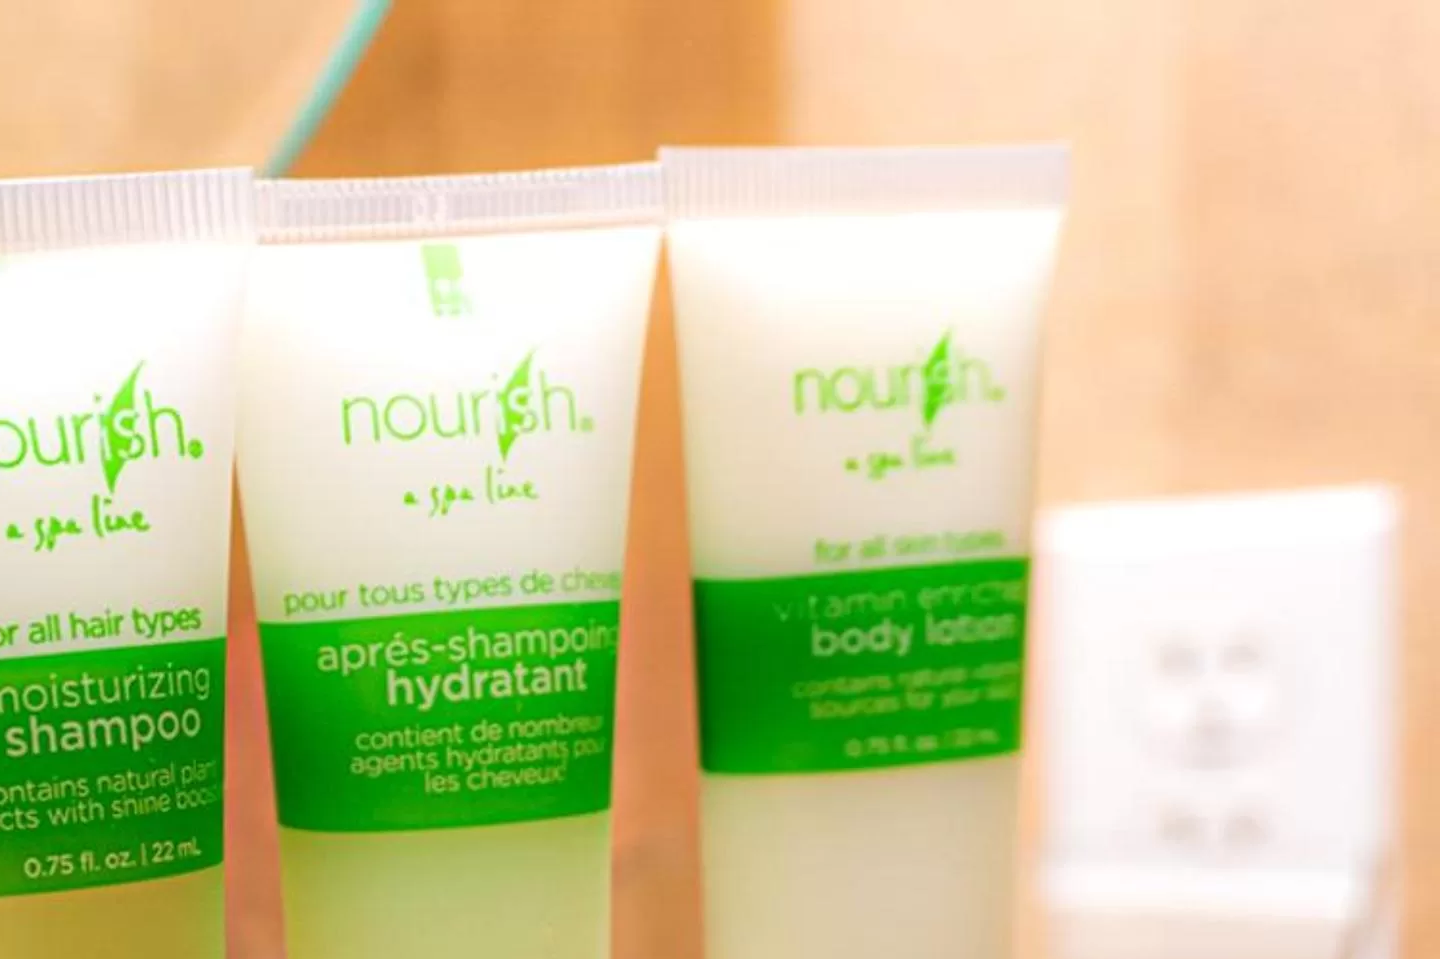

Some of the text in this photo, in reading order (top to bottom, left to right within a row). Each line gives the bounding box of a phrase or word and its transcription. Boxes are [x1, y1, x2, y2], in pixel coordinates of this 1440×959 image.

[403, 464, 539, 517] a spa line
[6, 493, 151, 552] a spa line
[815, 538, 851, 562] for
[861, 533, 888, 558] all
[283, 587, 350, 617] pour
[358, 581, 425, 608] tous
[432, 575, 511, 605] types
[519, 568, 555, 595] de
[28, 613, 60, 645] all
[68, 608, 124, 640] hair
[131, 607, 202, 639] types
[812, 617, 913, 657] body
[387, 658, 588, 711] hydratant
[4, 708, 202, 757] shampoo
[355, 722, 464, 751] contient
[470, 718, 503, 744] de
[350, 748, 438, 777] agents
[446, 738, 568, 771] hydratants
[96, 763, 175, 795] natural
[424, 764, 565, 795] les cheveux
[48, 798, 105, 826] with
[111, 790, 171, 821] shine
[23, 854, 75, 880] 0.75
[80, 850, 101, 875] fl.
[104, 848, 136, 871] oz.
[150, 839, 175, 864] 22
